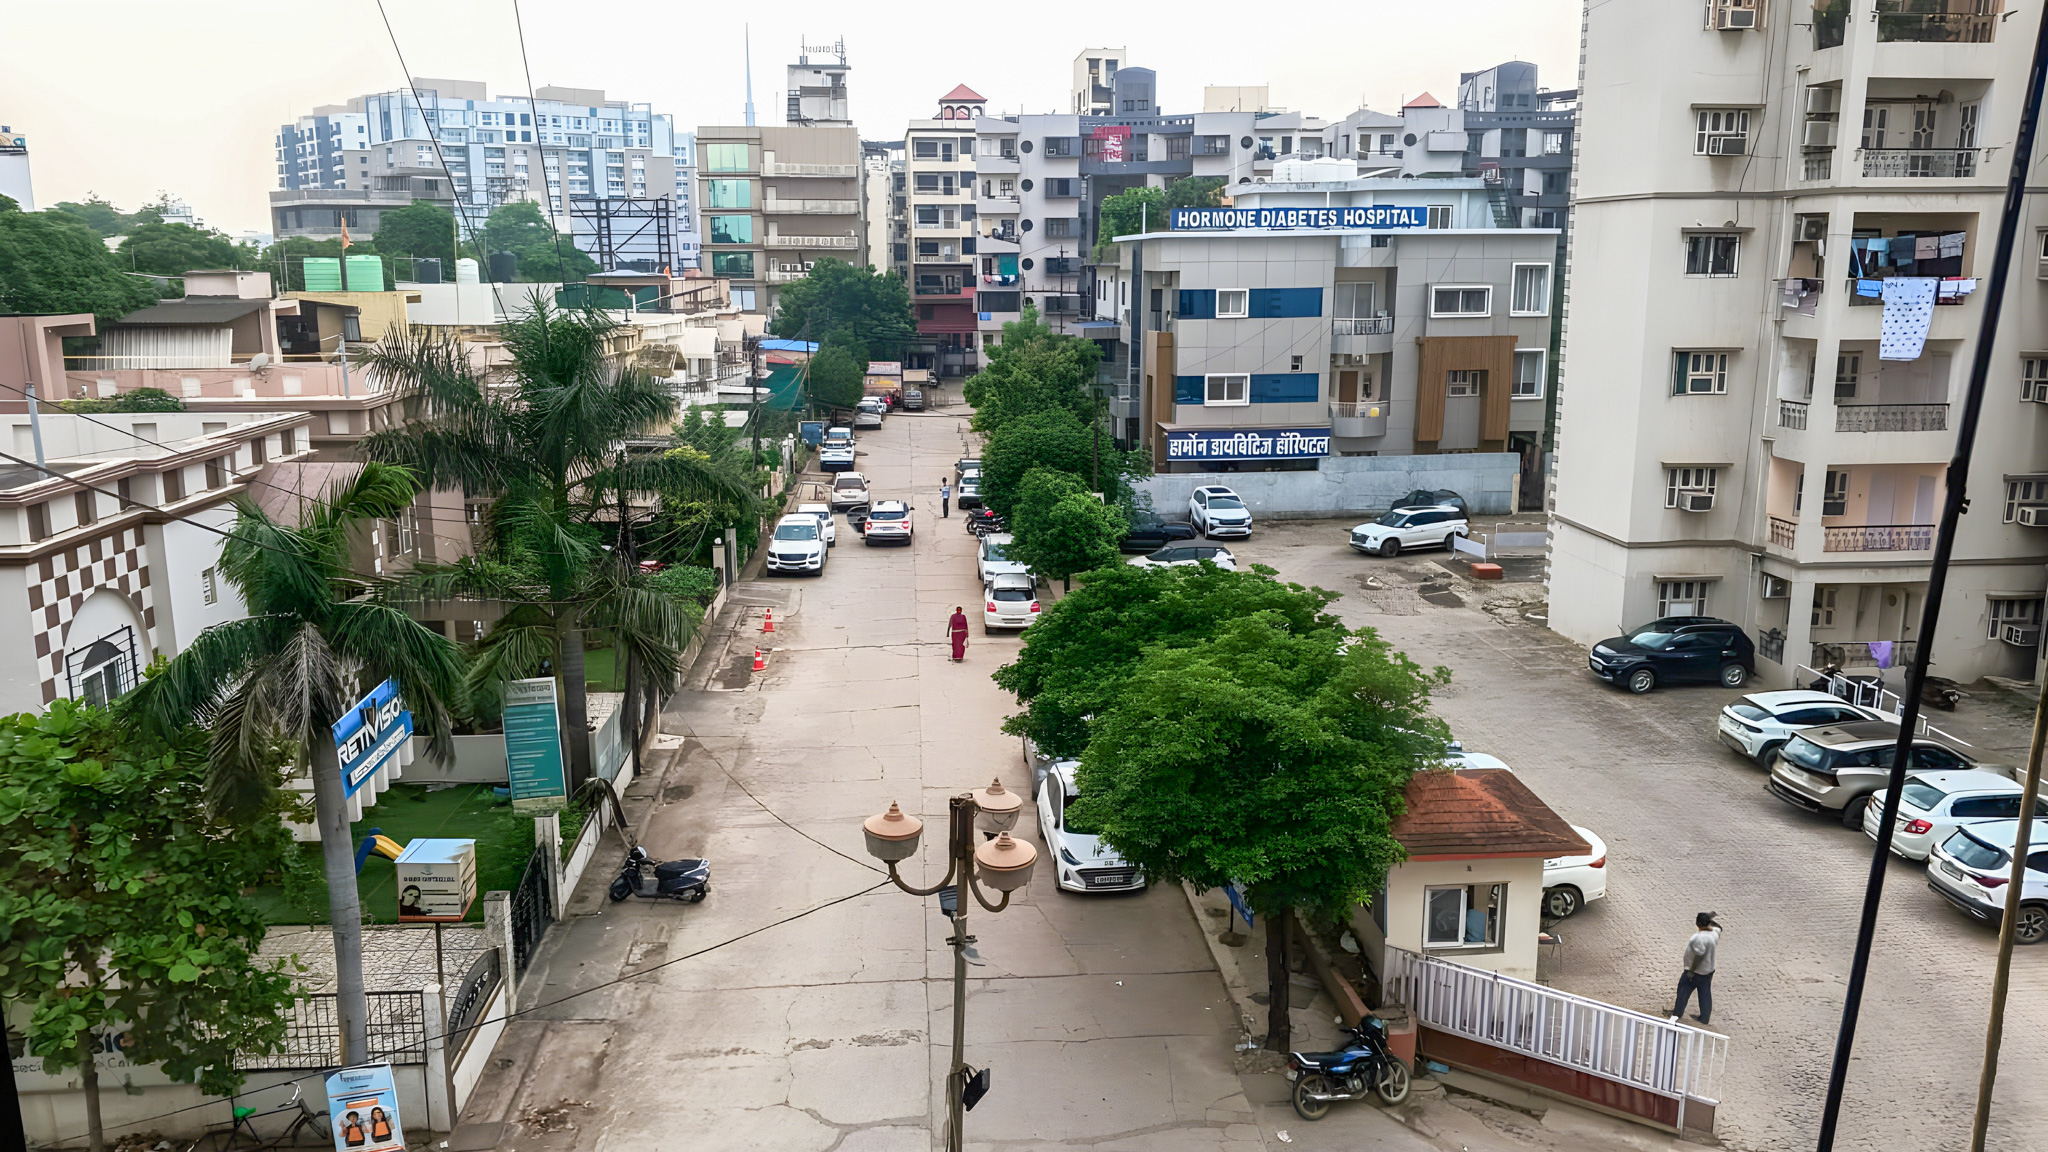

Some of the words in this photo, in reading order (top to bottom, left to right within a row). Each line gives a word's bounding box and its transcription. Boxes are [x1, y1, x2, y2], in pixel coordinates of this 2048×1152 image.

[1178, 211, 1257, 227] HORMONE
[1261, 210, 1337, 226] DIABETES
[1343, 209, 1419, 225] HOSPITAL
[1169, 432, 1207, 456] हार्मोन
